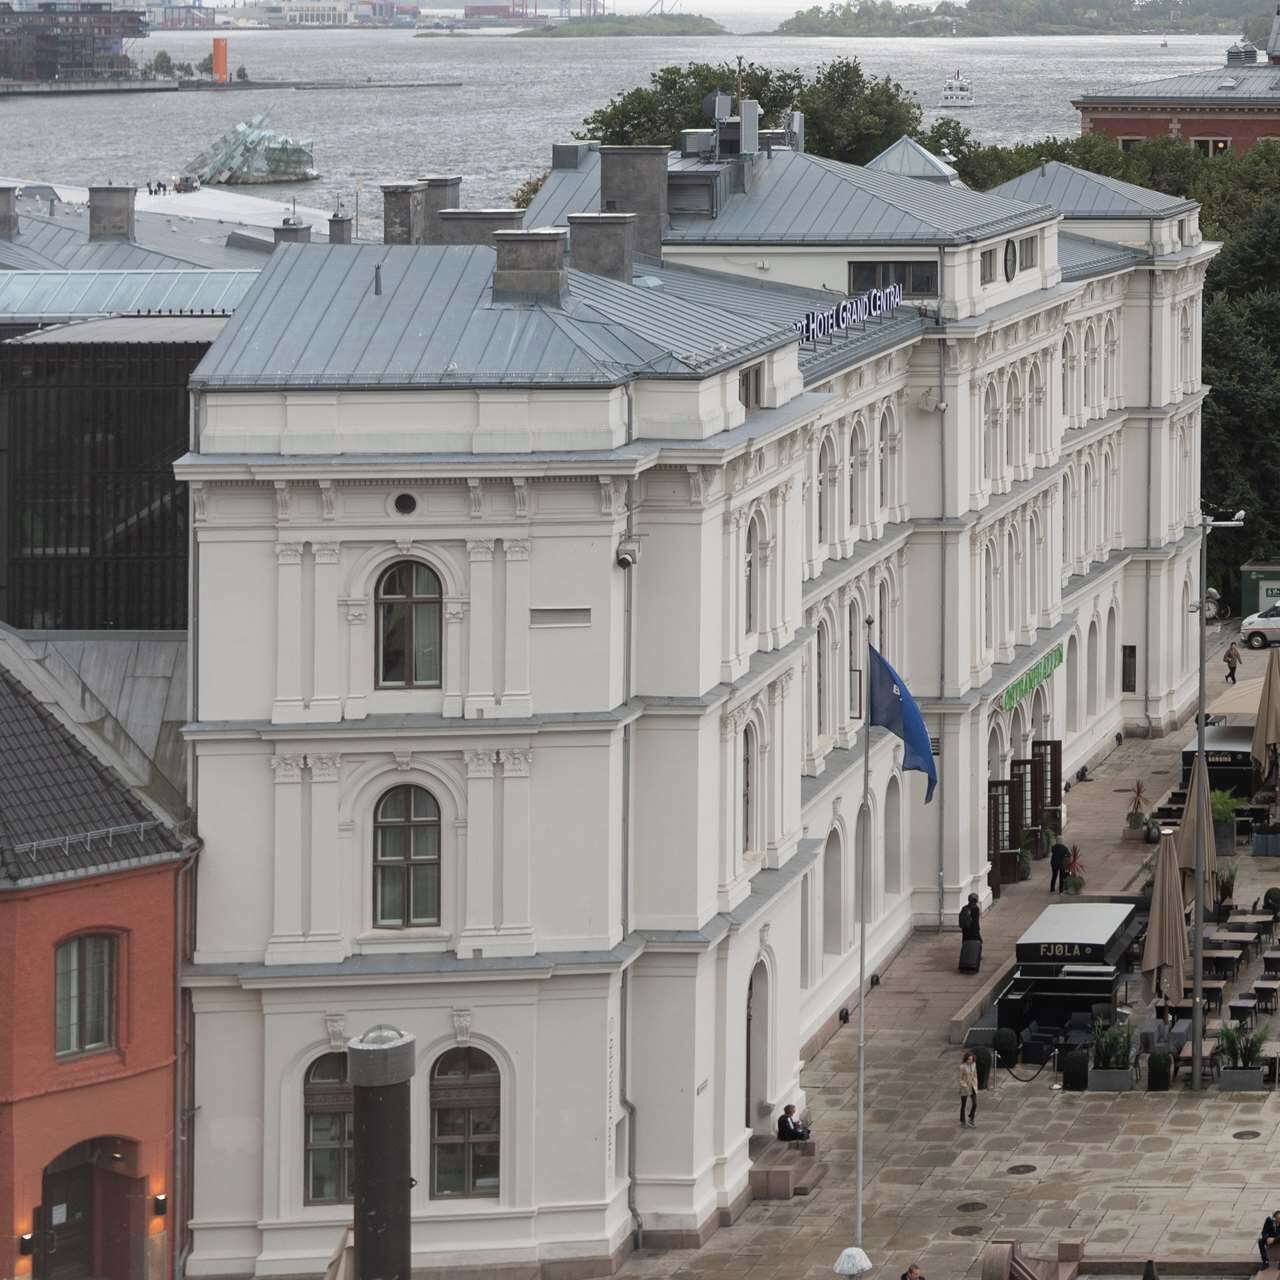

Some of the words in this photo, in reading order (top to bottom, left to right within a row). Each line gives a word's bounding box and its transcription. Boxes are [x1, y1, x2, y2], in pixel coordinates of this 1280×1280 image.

[809, 307, 837, 341] HOTEL
[840, 297, 869, 329] GRAND
[870, 283, 903, 316] CENTRAL
[1040, 943, 1081, 957] FJØLA
